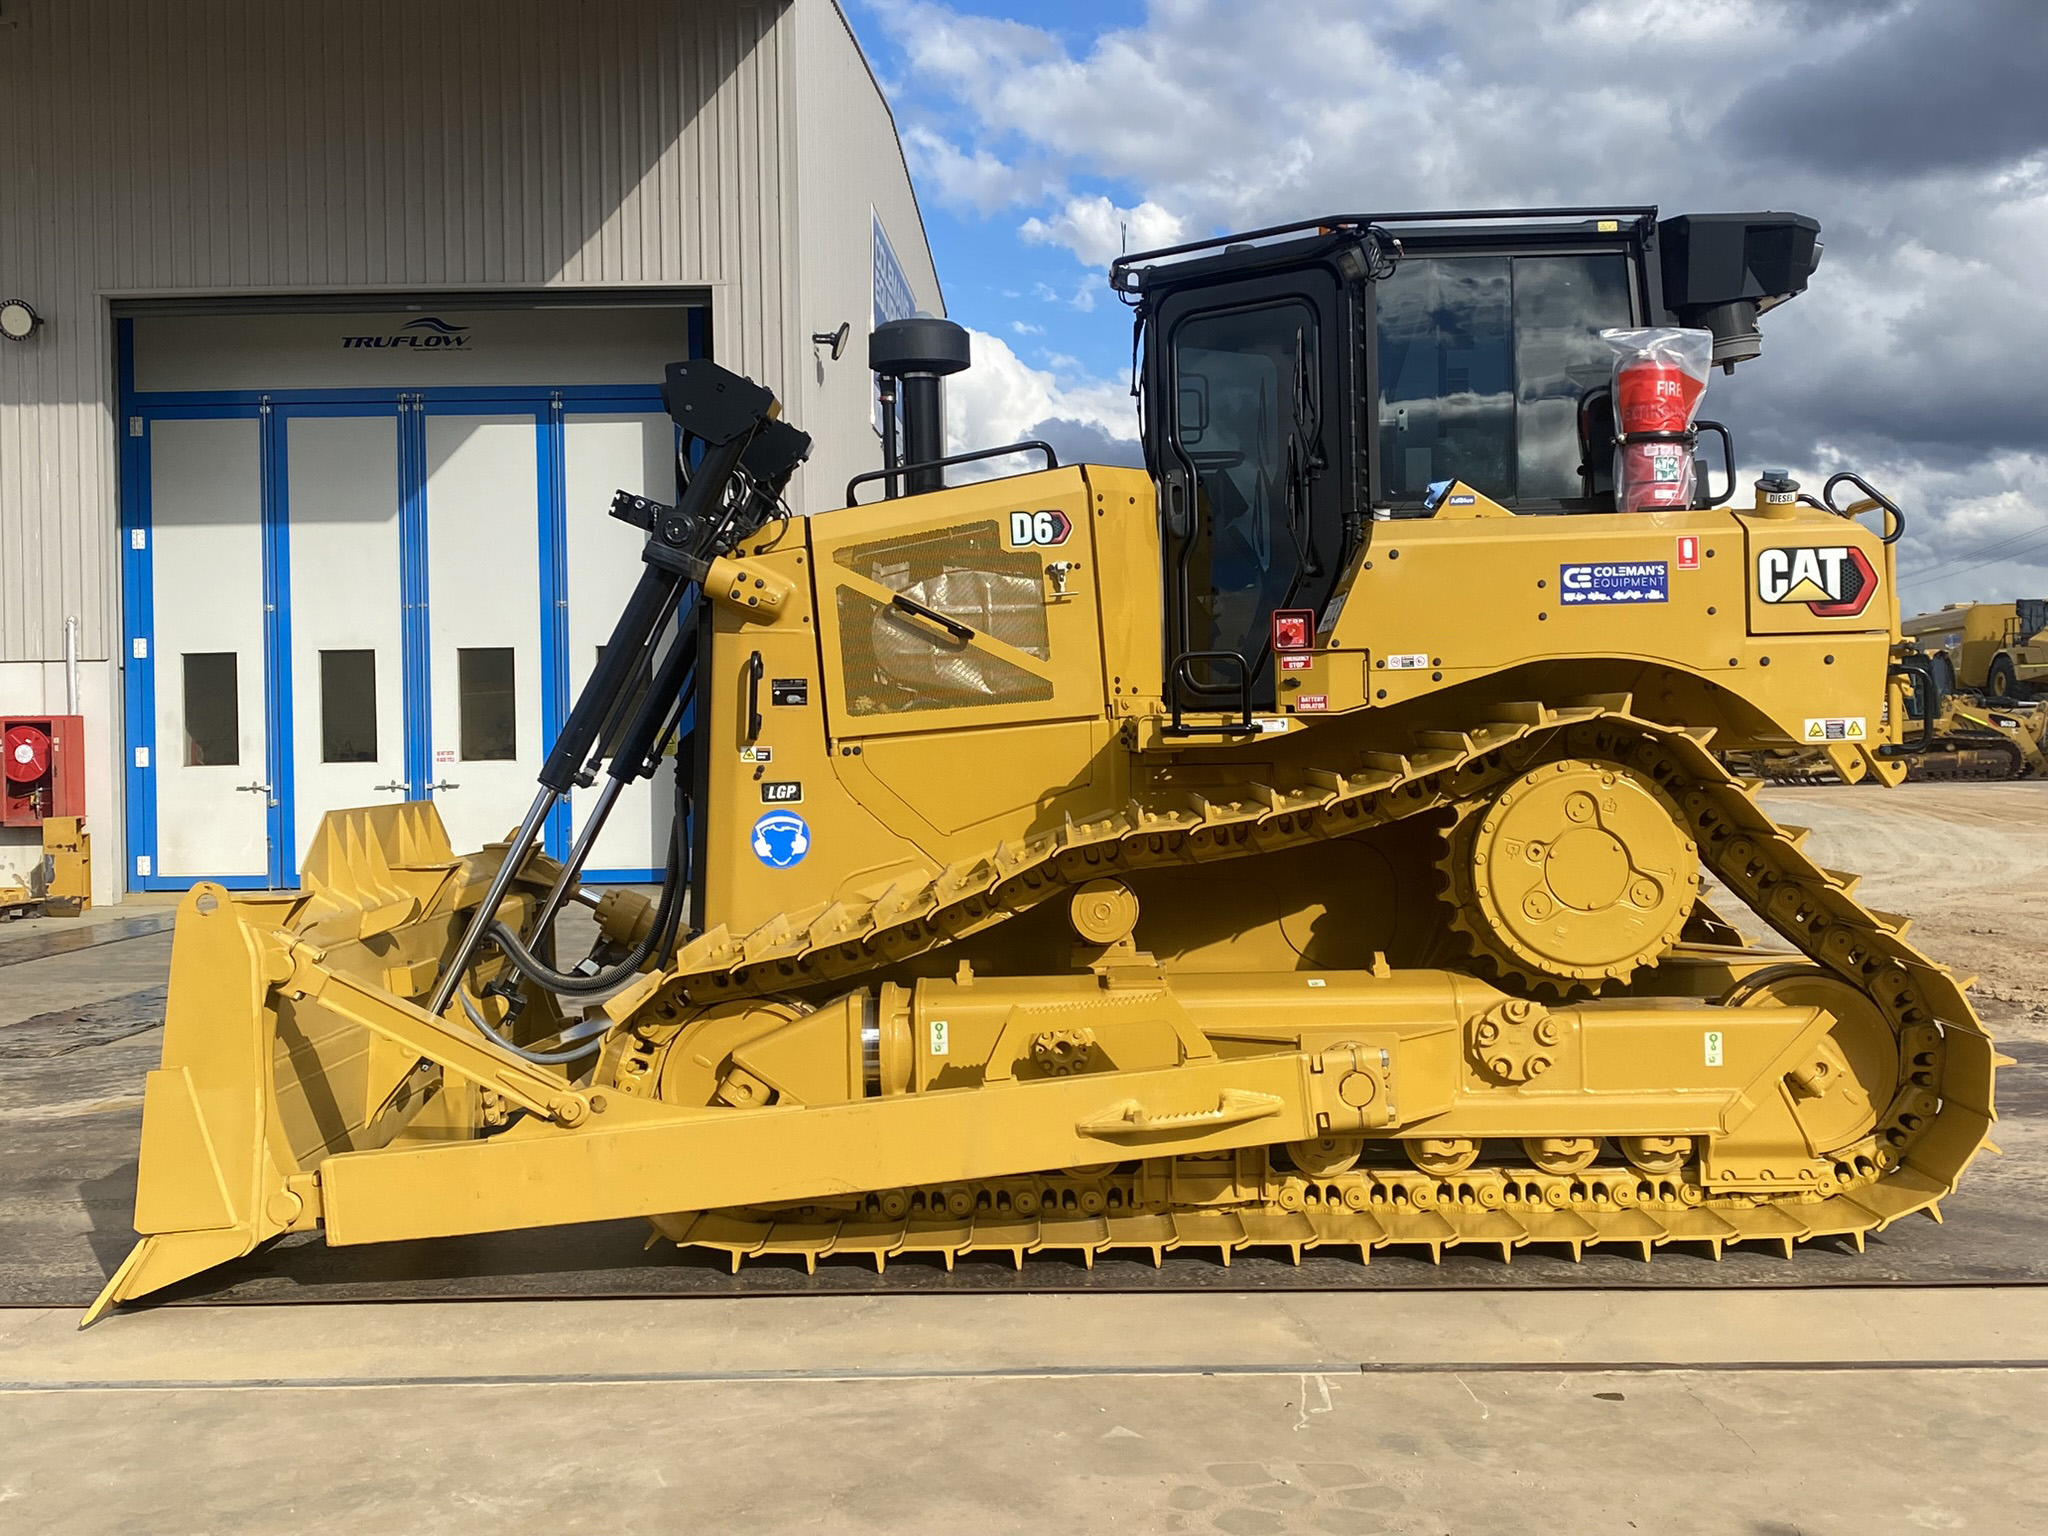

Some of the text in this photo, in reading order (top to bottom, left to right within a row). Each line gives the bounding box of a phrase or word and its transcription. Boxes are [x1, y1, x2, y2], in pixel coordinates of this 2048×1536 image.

[341, 335, 471, 348] TRUFLOW
[1656, 380, 1682, 397] FIRE
[1769, 493, 1794, 503] DIESEL
[1011, 511, 1053, 544] D6
[1593, 565, 1665, 577] COLEMAN'S
[1759, 548, 1848, 602] CAT
[1593, 576, 1665, 588] EQUIPMENT
[1288, 661, 1305, 669] STOP
[768, 785, 797, 799] LGP
